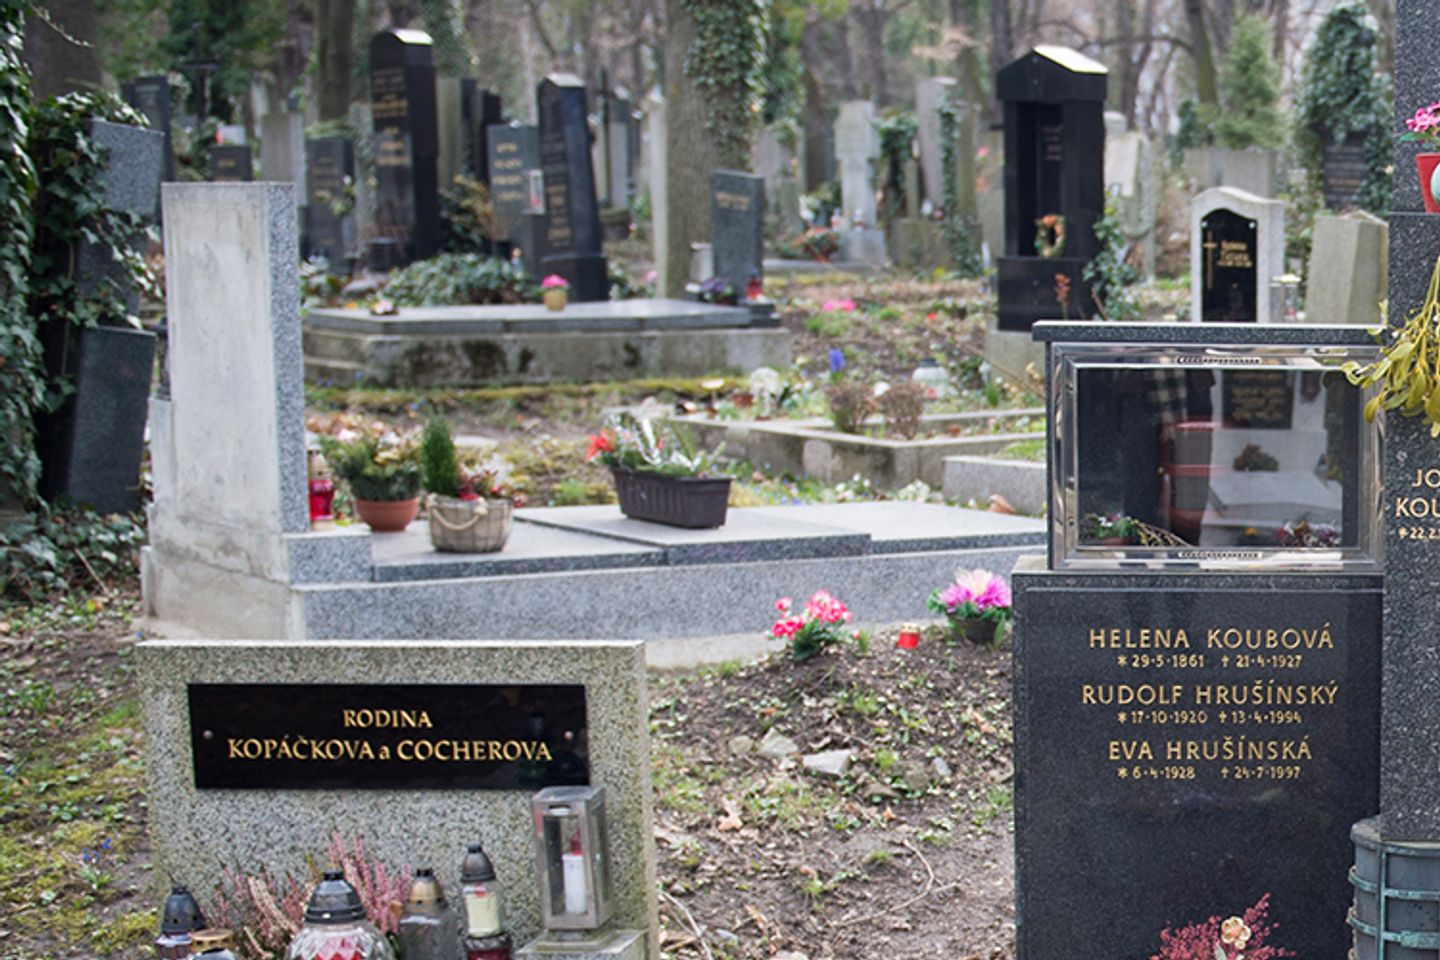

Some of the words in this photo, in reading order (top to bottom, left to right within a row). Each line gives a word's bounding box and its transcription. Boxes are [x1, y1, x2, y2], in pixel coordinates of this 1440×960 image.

[1089, 628, 1190, 649] HELENA
[1206, 622, 1334, 650] KOUBOVÁ
[1081, 684, 1183, 705] RUDOLF
[1195, 679, 1339, 705] HRUŠÍNSKÝ
[342, 708, 434, 729] RODINA
[227, 734, 375, 760] KOPÁČKOVA
[378, 745, 392, 760] a
[396, 739, 553, 762] COCHEROVA
[1108, 740, 1154, 760] EVA
[1166, 735, 1313, 760] HRUŠÍNSKÁ
